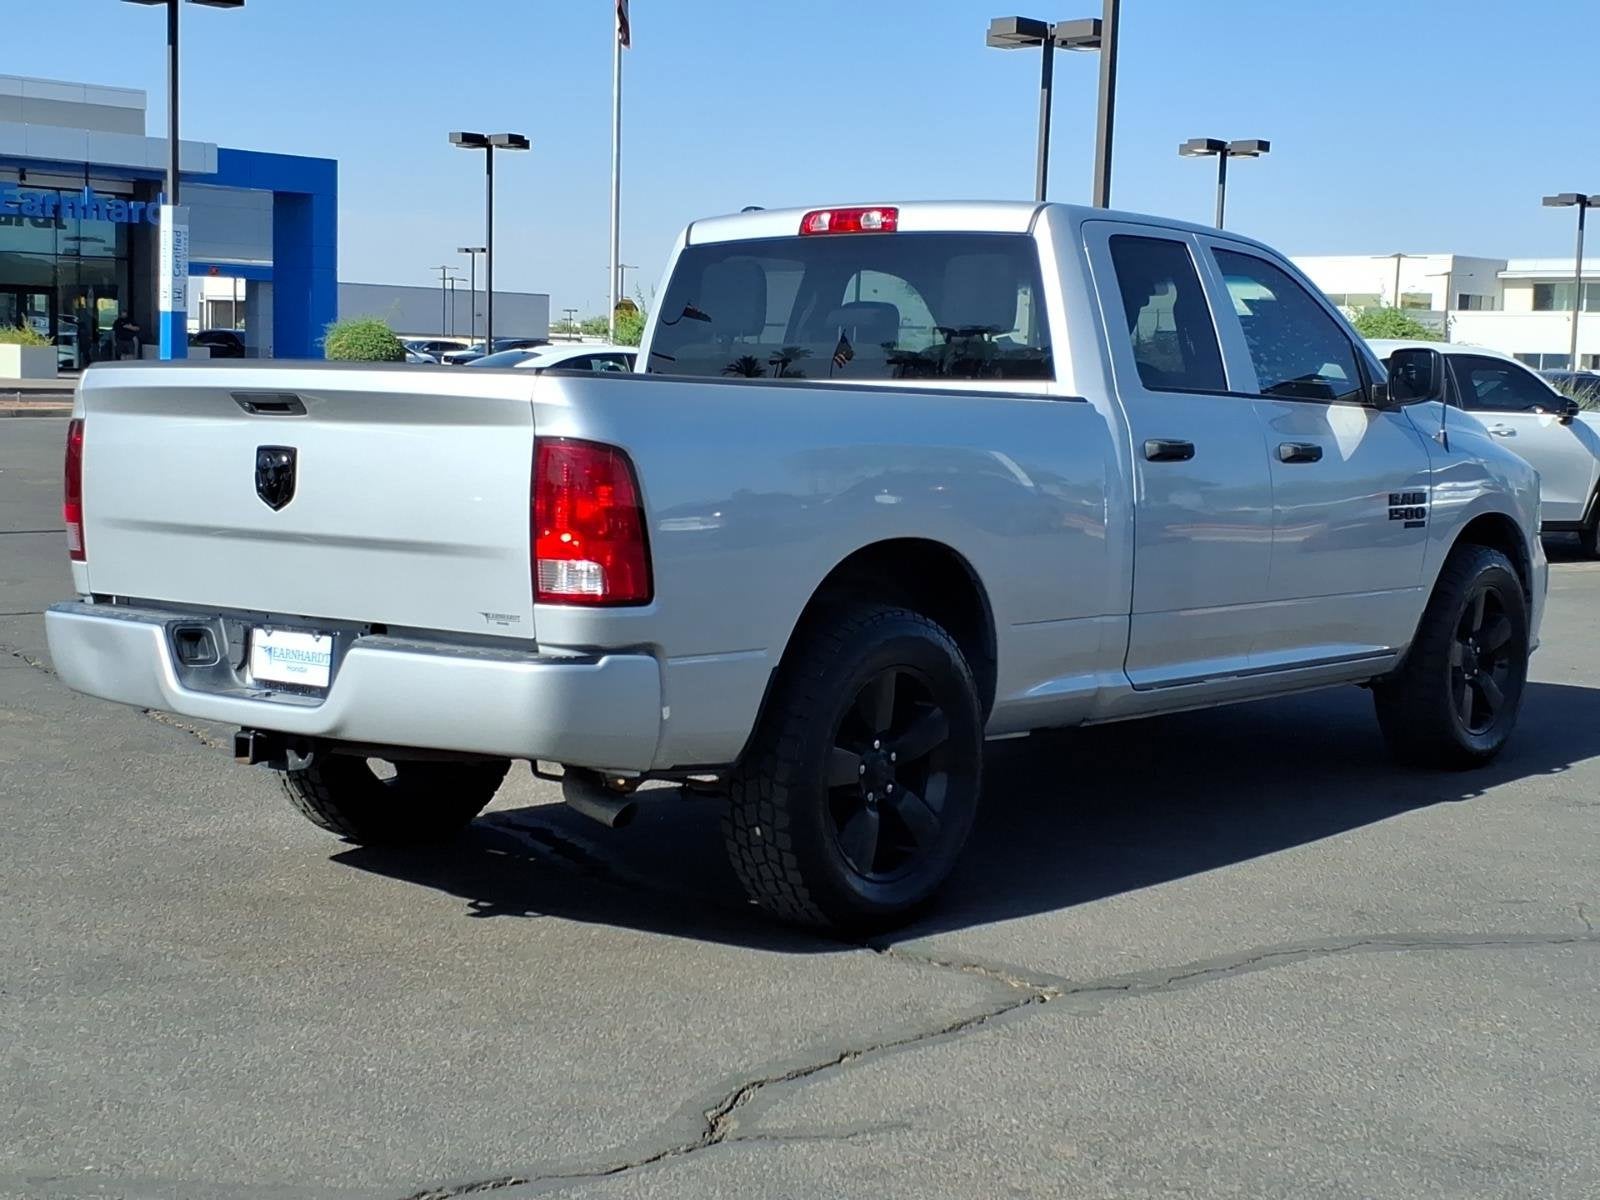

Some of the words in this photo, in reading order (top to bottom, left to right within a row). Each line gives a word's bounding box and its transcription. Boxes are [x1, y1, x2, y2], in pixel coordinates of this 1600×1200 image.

[0, 182, 168, 225] Earnhard
[173, 230, 181, 277] Certified
[1389, 507, 1426, 520] 1500
[273, 647, 329, 664] EARNHARDT
